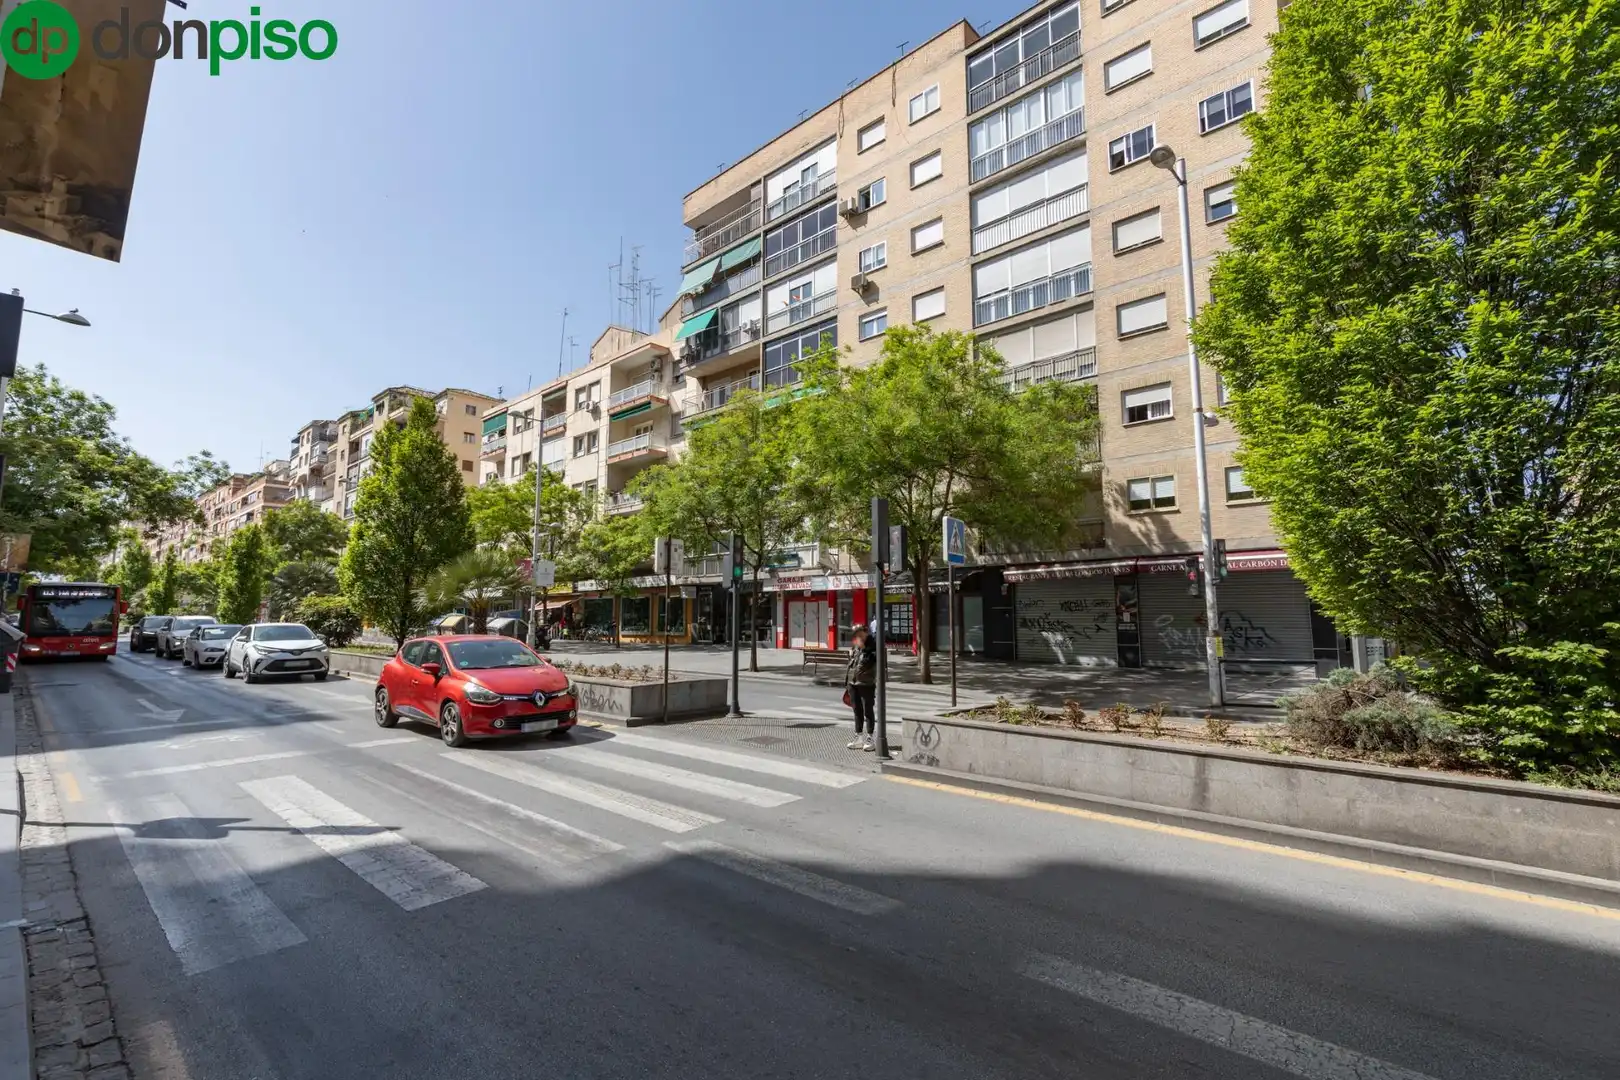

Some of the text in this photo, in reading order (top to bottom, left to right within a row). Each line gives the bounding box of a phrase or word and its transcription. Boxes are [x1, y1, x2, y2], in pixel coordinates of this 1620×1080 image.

[1150, 565, 1178, 573] CARNE
[1239, 558, 1278, 569] CARBÓN
[777, 576, 805, 584] GARAJE
